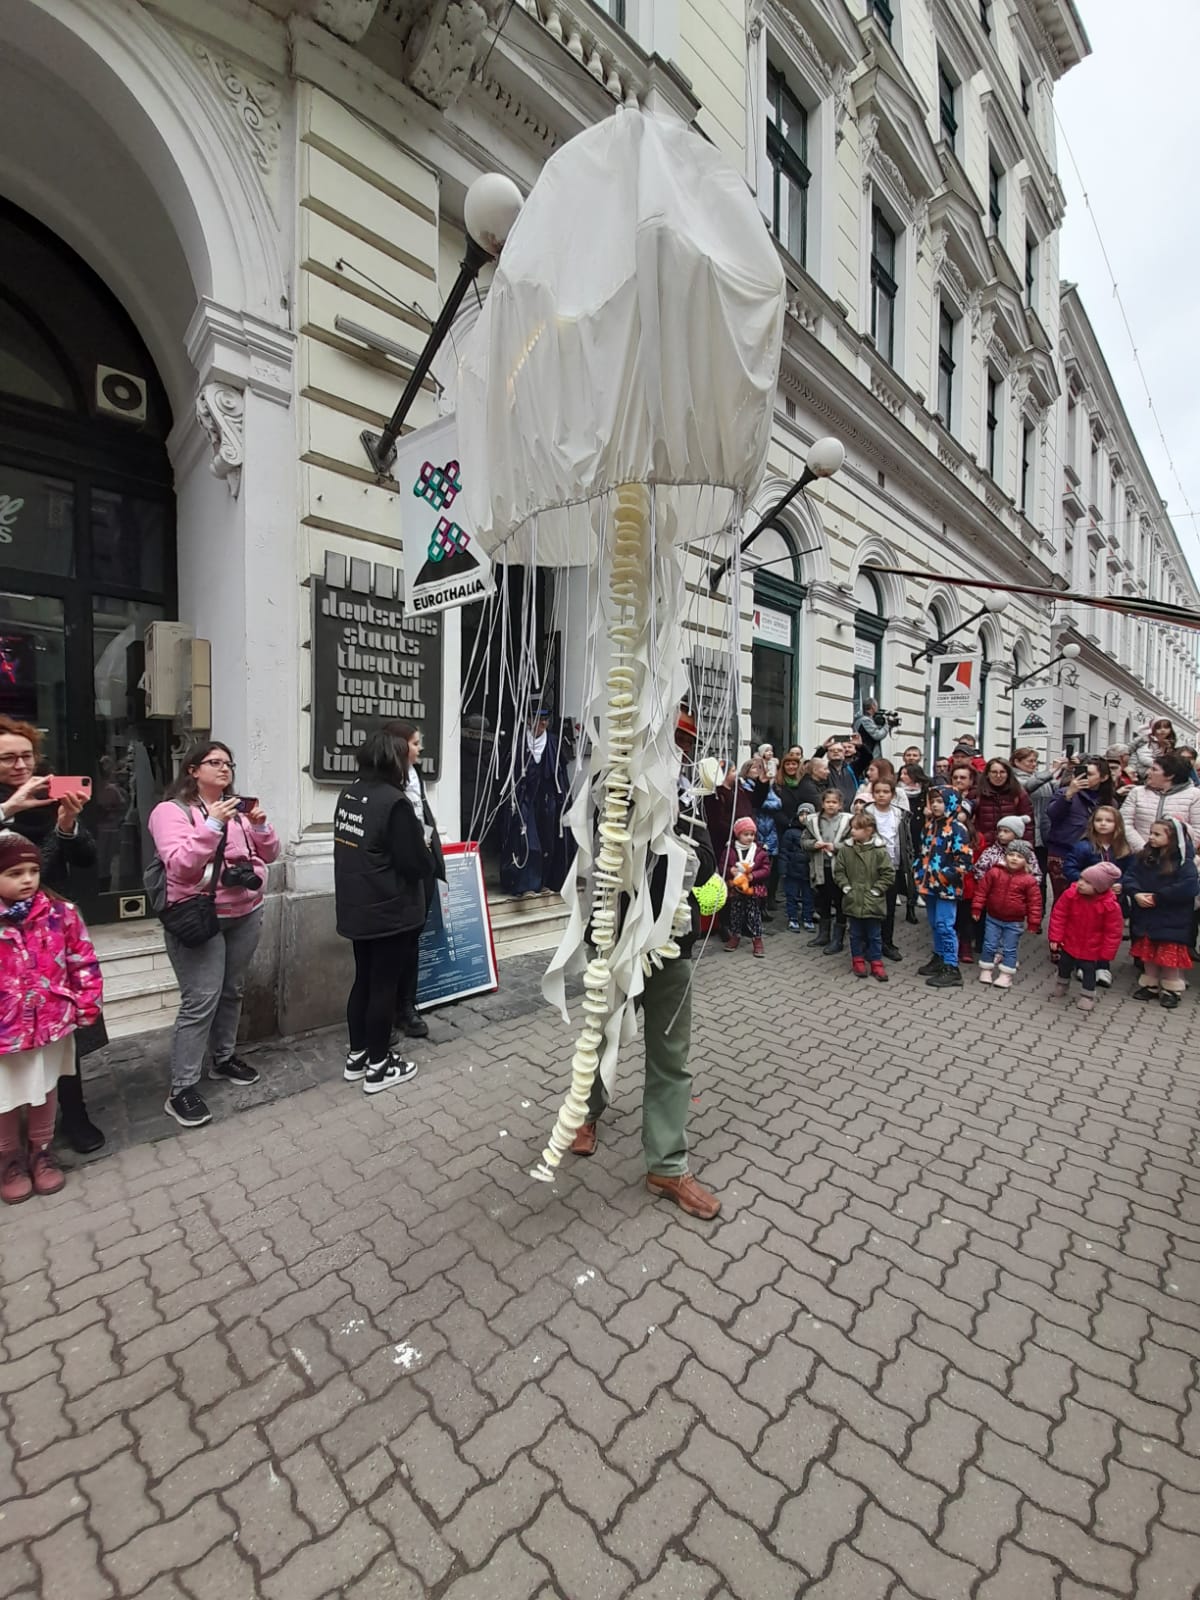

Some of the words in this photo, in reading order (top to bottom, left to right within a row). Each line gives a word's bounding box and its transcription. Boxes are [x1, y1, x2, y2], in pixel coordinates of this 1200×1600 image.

[413, 579, 486, 611] EUROTHALIA
[322, 591, 438, 636] deutsches
[344, 623, 420, 655] staats
[337, 642, 425, 678] theater
[337, 669, 421, 702] teatrul
[337, 695, 425, 720] german
[336, 720, 367, 747] de
